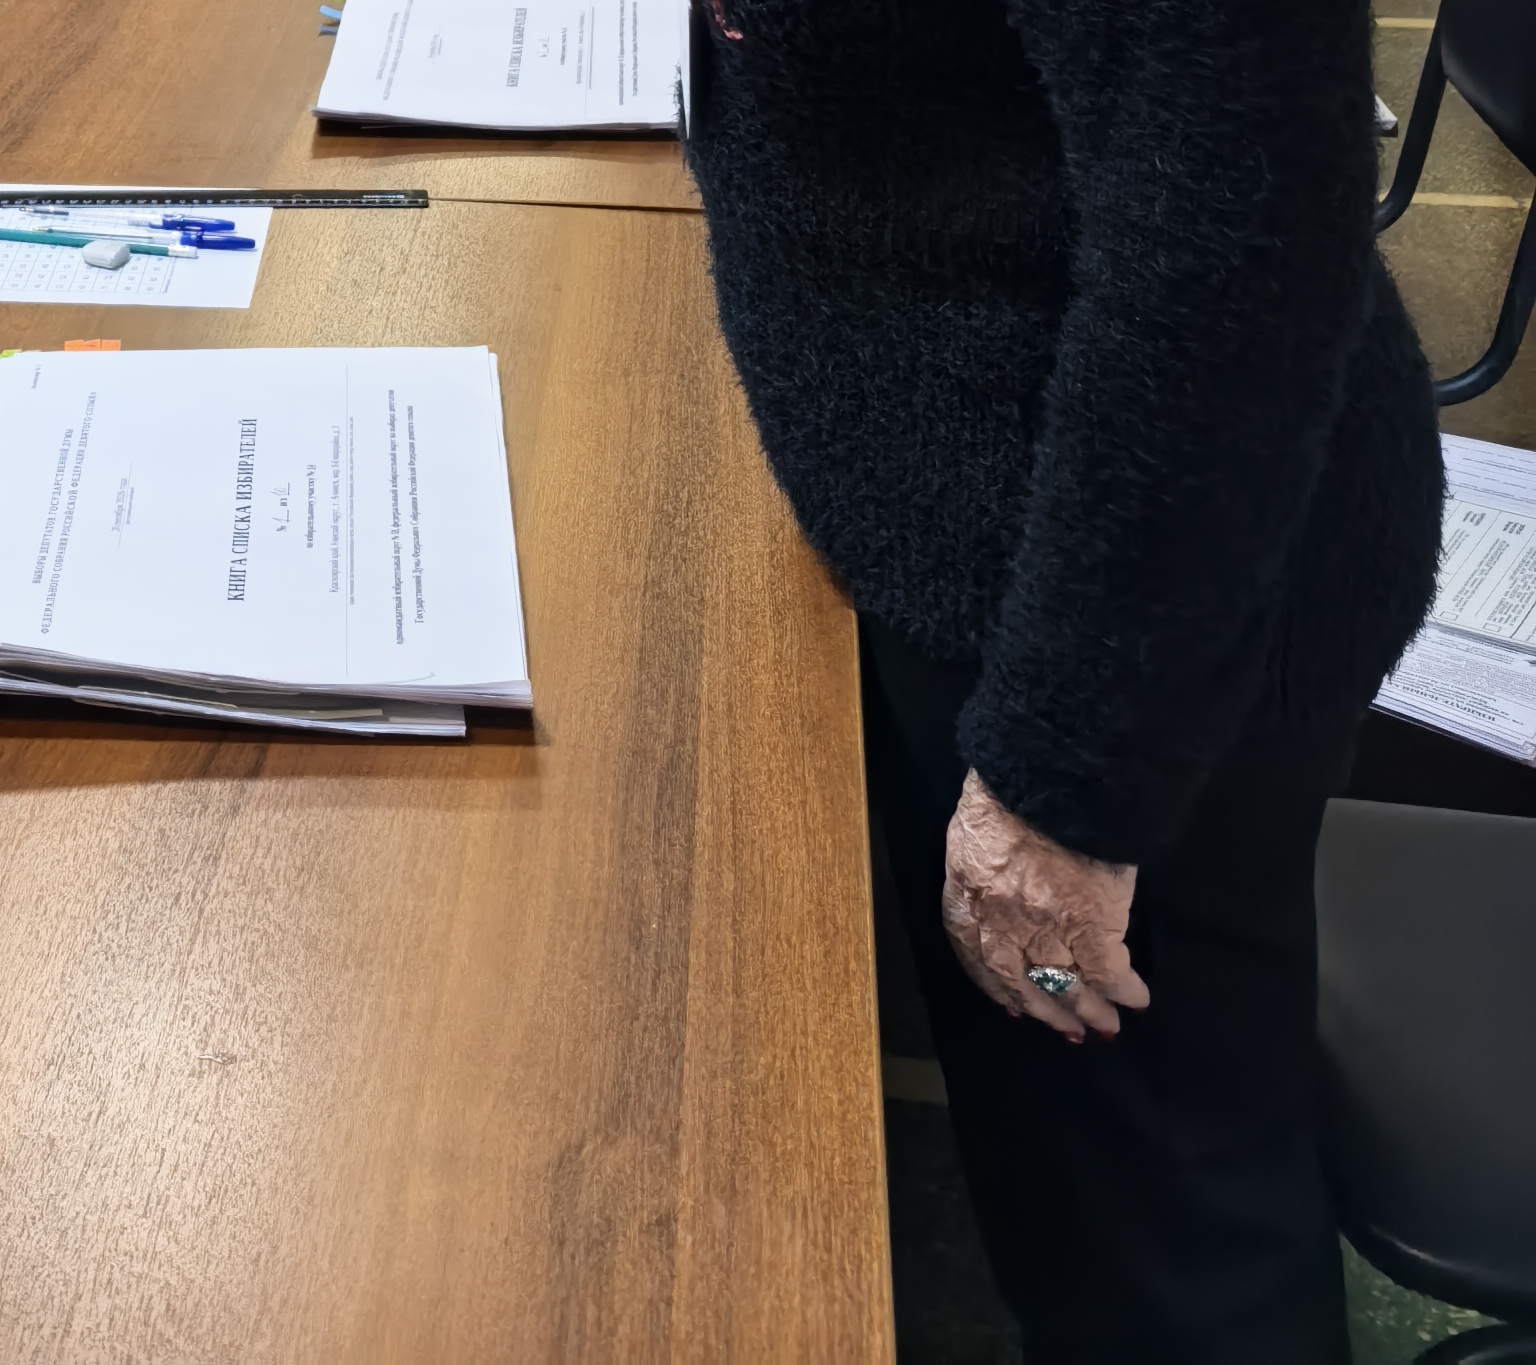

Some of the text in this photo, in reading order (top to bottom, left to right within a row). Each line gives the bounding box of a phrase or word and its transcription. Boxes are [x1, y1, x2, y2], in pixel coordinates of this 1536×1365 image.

[228, 419, 257, 602] КНИГА СПИСКА ИЗБИРАТЕЛЕЙ
